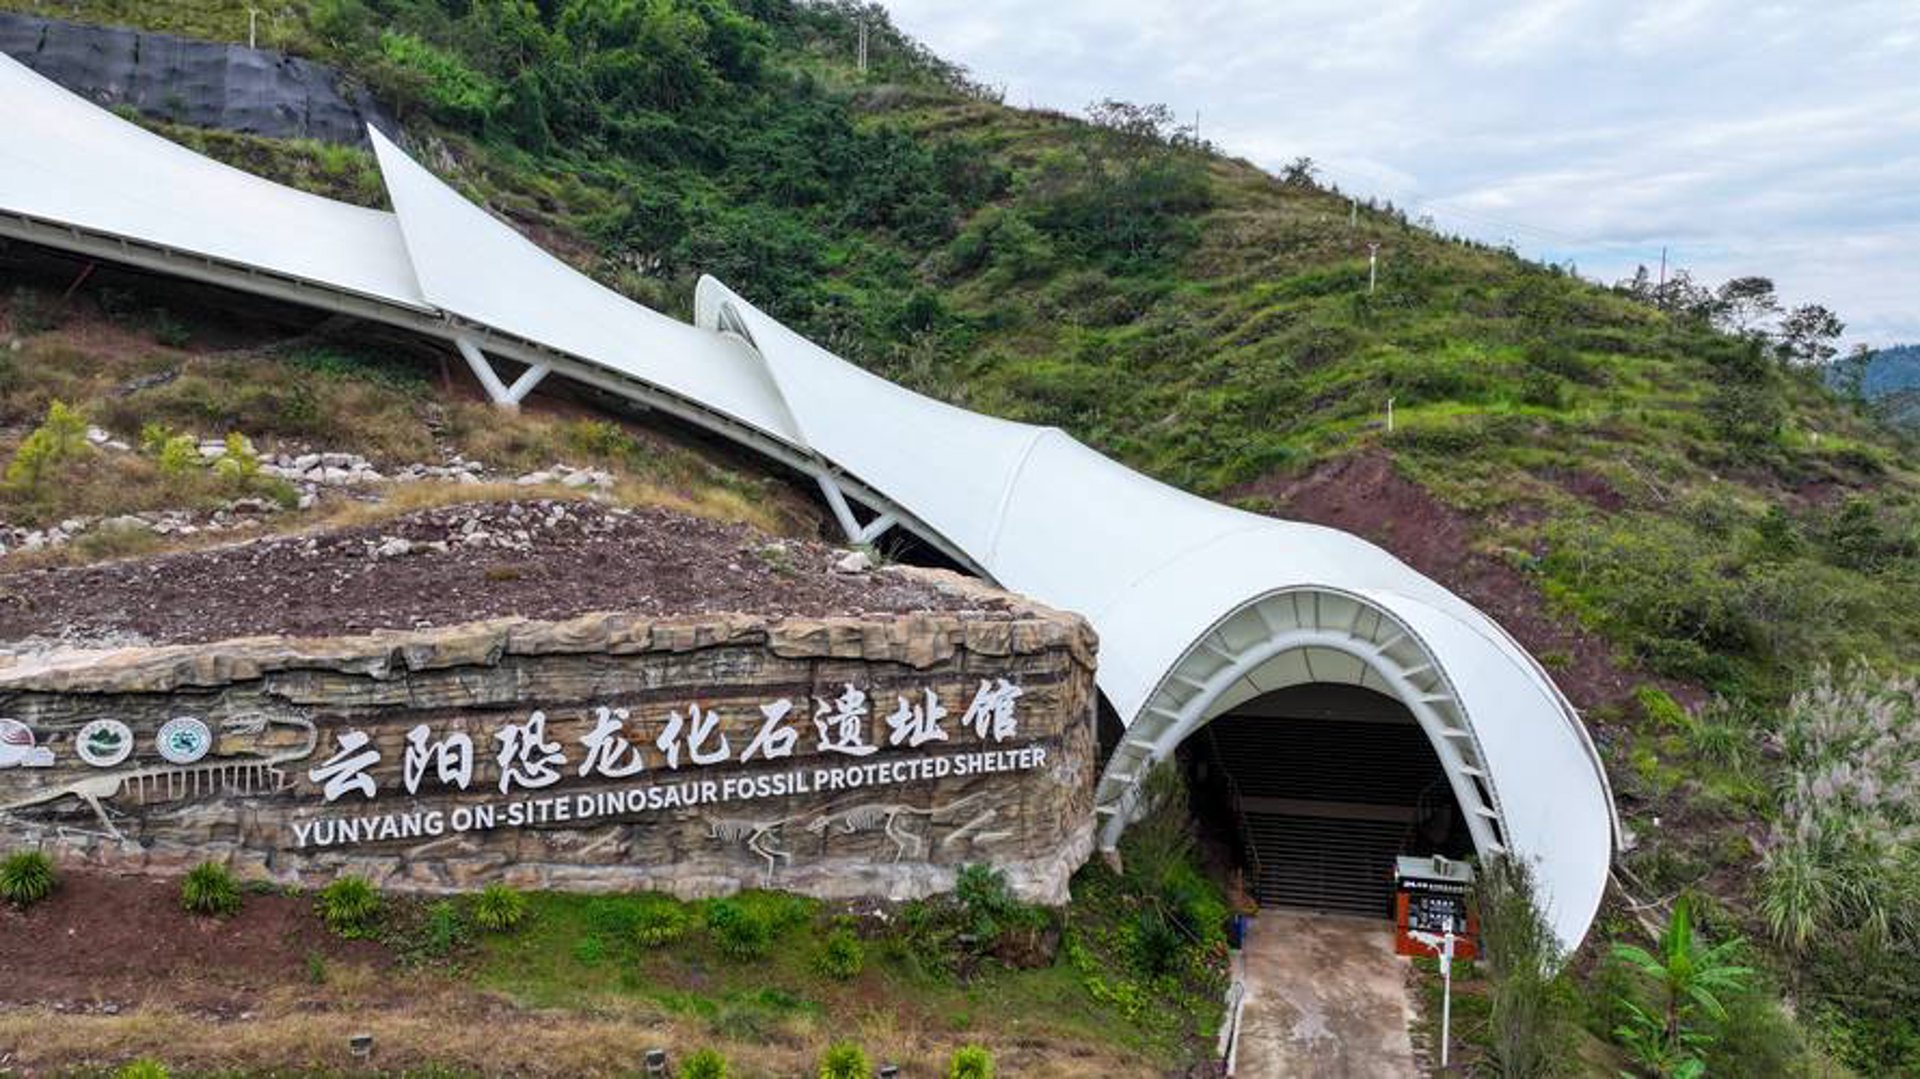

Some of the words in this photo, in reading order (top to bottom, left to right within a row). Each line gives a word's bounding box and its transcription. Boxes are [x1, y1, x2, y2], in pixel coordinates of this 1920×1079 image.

[308, 678, 1023, 801] 云阳恐龙化石遗址馆
[293, 810, 444, 848] YUNYANG
[453, 796, 571, 831] ON-SITE
[577, 781, 718, 818] DINOSAUR
[723, 768, 809, 799] FOSSIL
[814, 758, 948, 788] PROTECTED
[953, 748, 1047, 774] SHELTER
